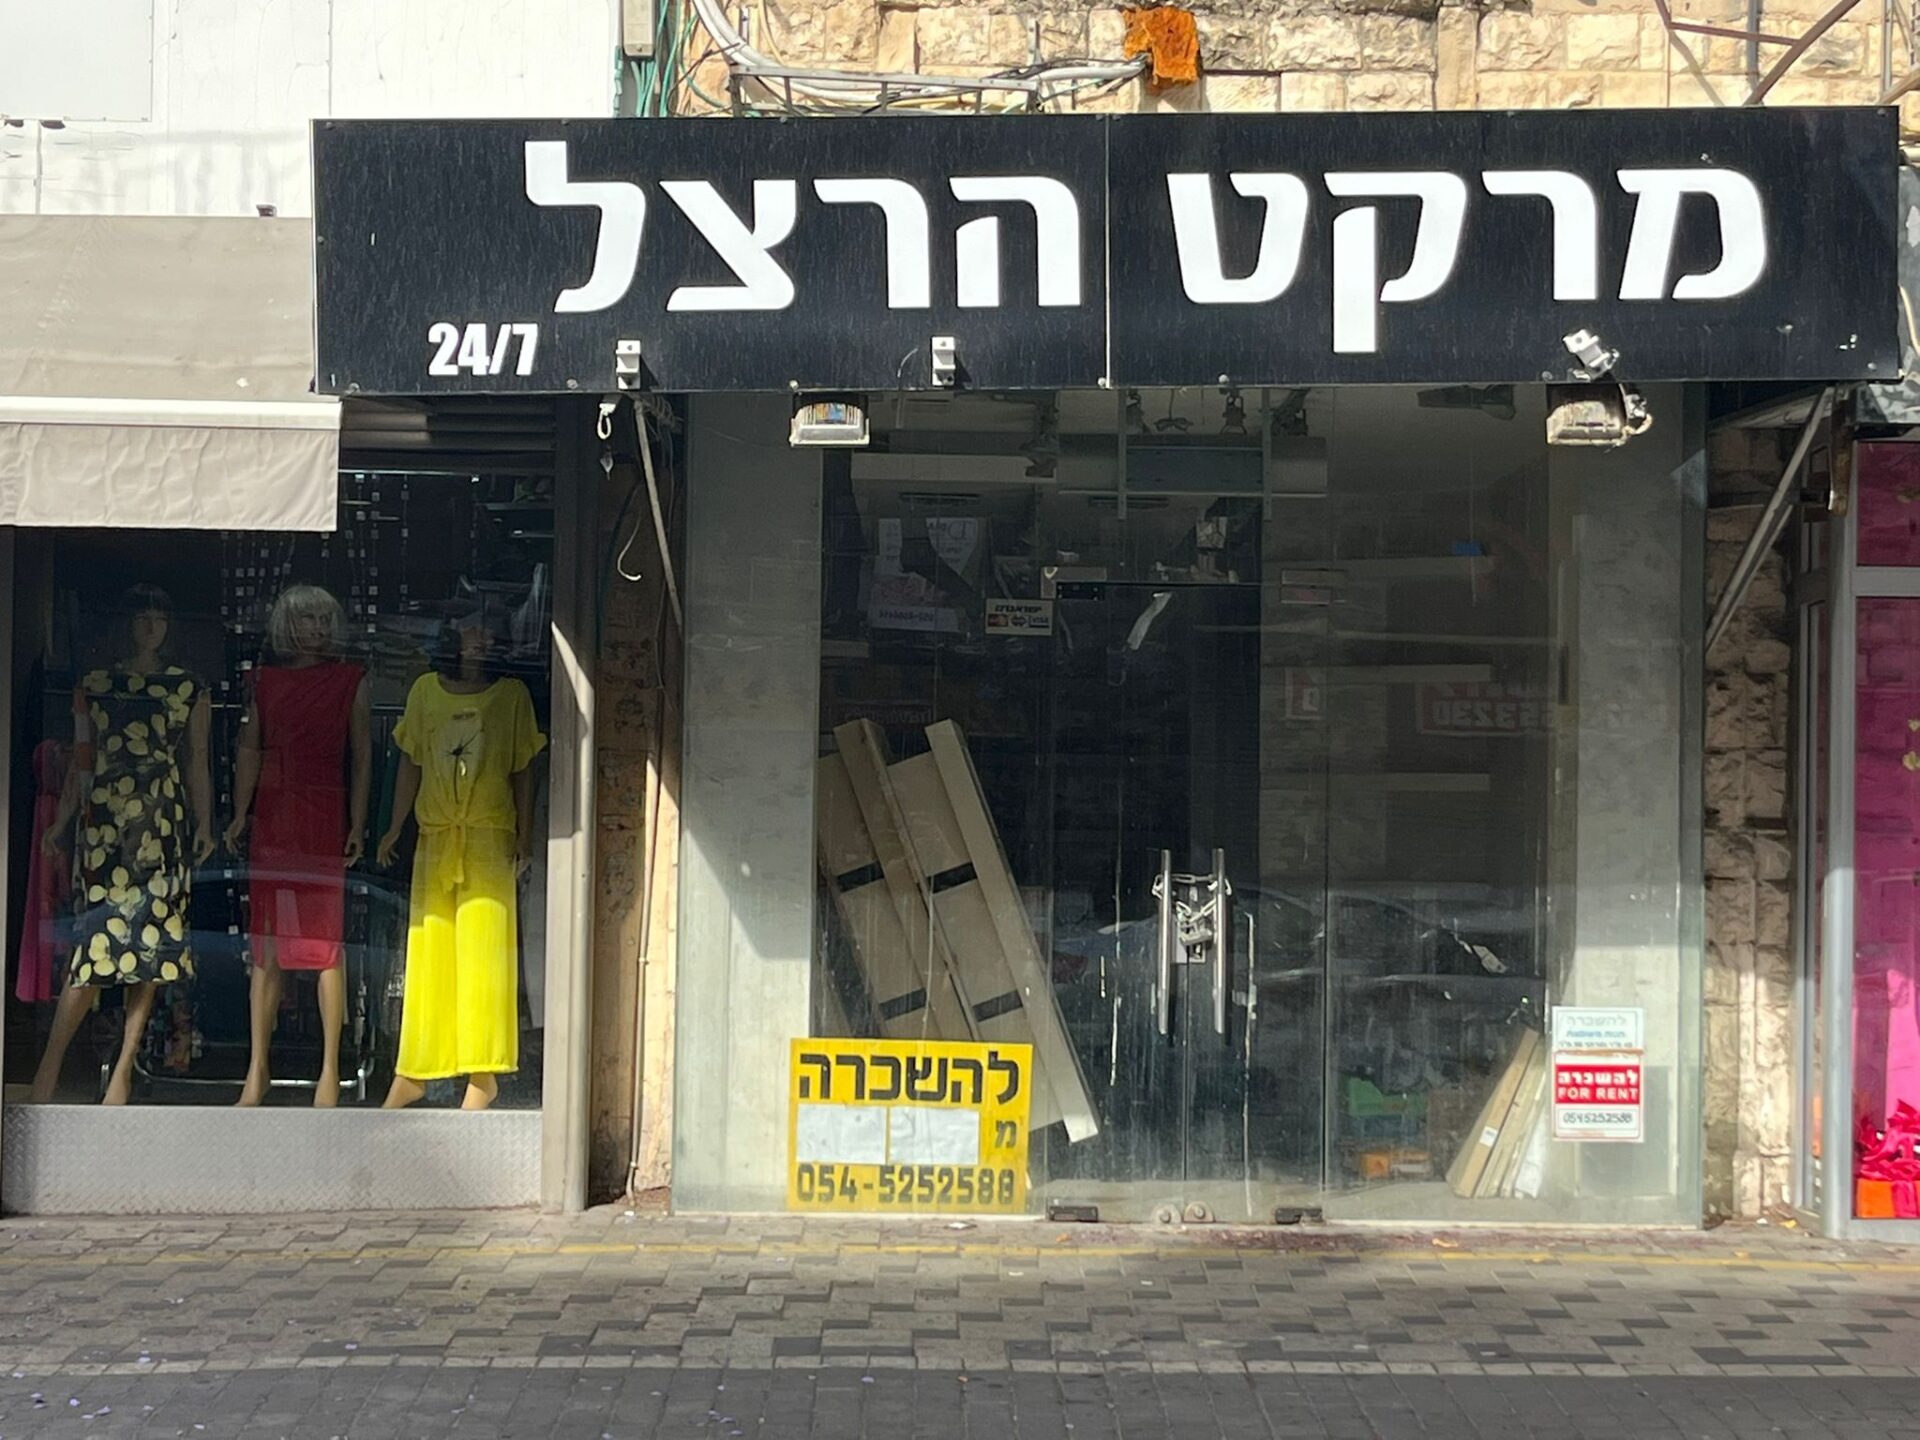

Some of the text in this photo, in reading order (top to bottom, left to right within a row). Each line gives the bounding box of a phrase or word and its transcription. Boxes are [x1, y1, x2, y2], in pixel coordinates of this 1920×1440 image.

[525, 140, 1767, 353] מרקט הרצל
[427, 323, 538, 375] 24/7
[1566, 1014, 1627, 1027] להשכרה
[799, 1051, 1019, 1105] להשכרה
[1557, 1069, 1638, 1085] להשכרה
[1557, 1087, 1638, 1100] FOR RENT
[798, 1163, 1015, 1205] 054-5252588
